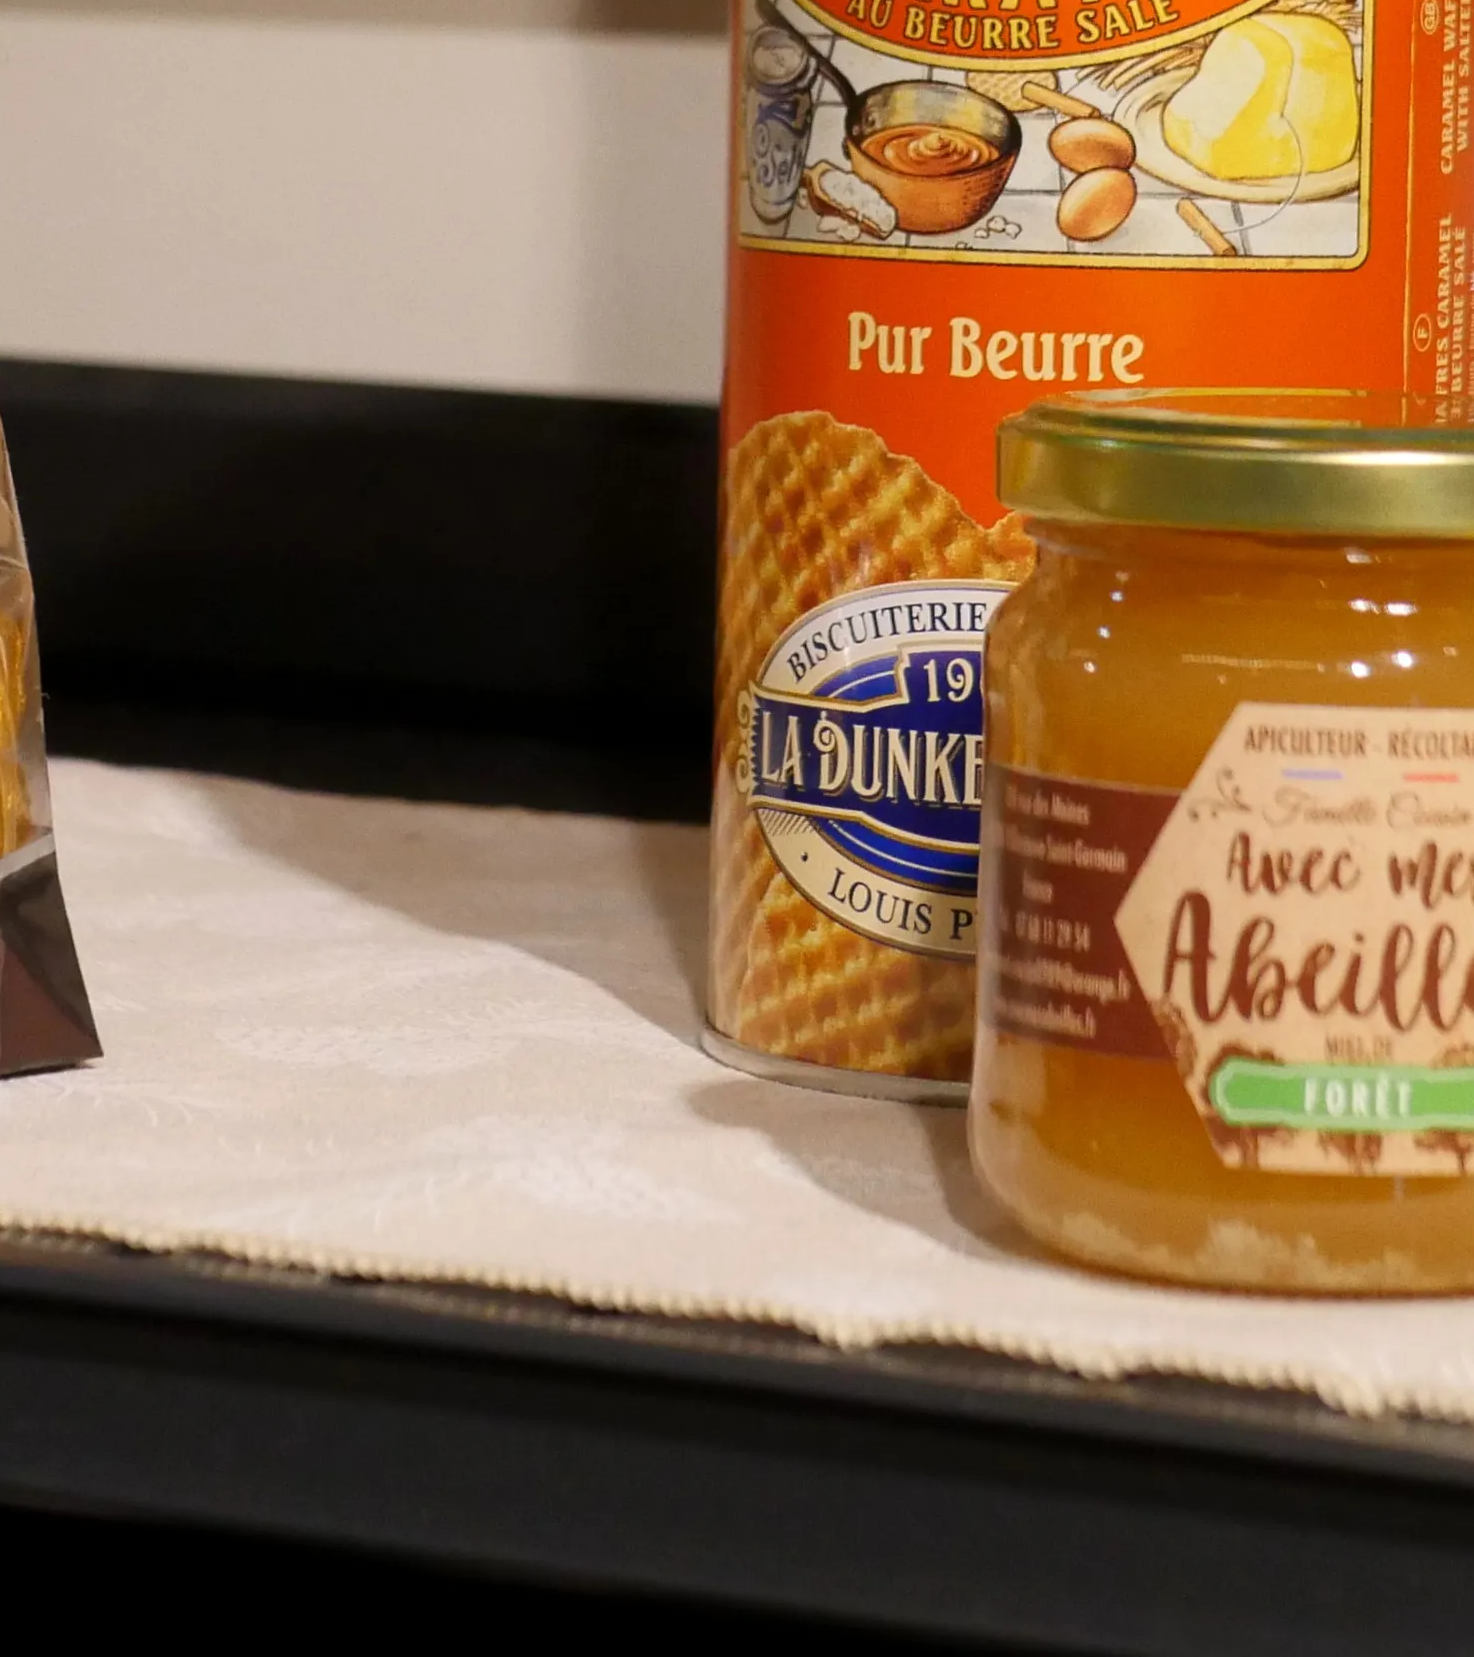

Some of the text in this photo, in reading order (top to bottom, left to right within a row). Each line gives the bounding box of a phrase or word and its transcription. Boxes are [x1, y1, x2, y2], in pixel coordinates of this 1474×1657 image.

[905, 6, 1059, 51] BEURRE
[1440, 59, 1456, 174] CARAMEL
[1455, 86, 1470, 152] WITH
[1436, 212, 1452, 329] CARAMEL
[1451, 226, 1466, 393] BEURRE SALÉ
[847, 310, 1145, 384] Pur Beurre
[786, 600, 988, 684] BISCUITERIE
[922, 655, 976, 704] 19
[760, 710, 983, 806] LA DUNKE
[1244, 725, 1367, 758] APICULTEUR
[1227, 830, 1361, 895] Avec
[827, 867, 933, 935] LOUIS
[1304, 1072, 1413, 1121] FORÊT
